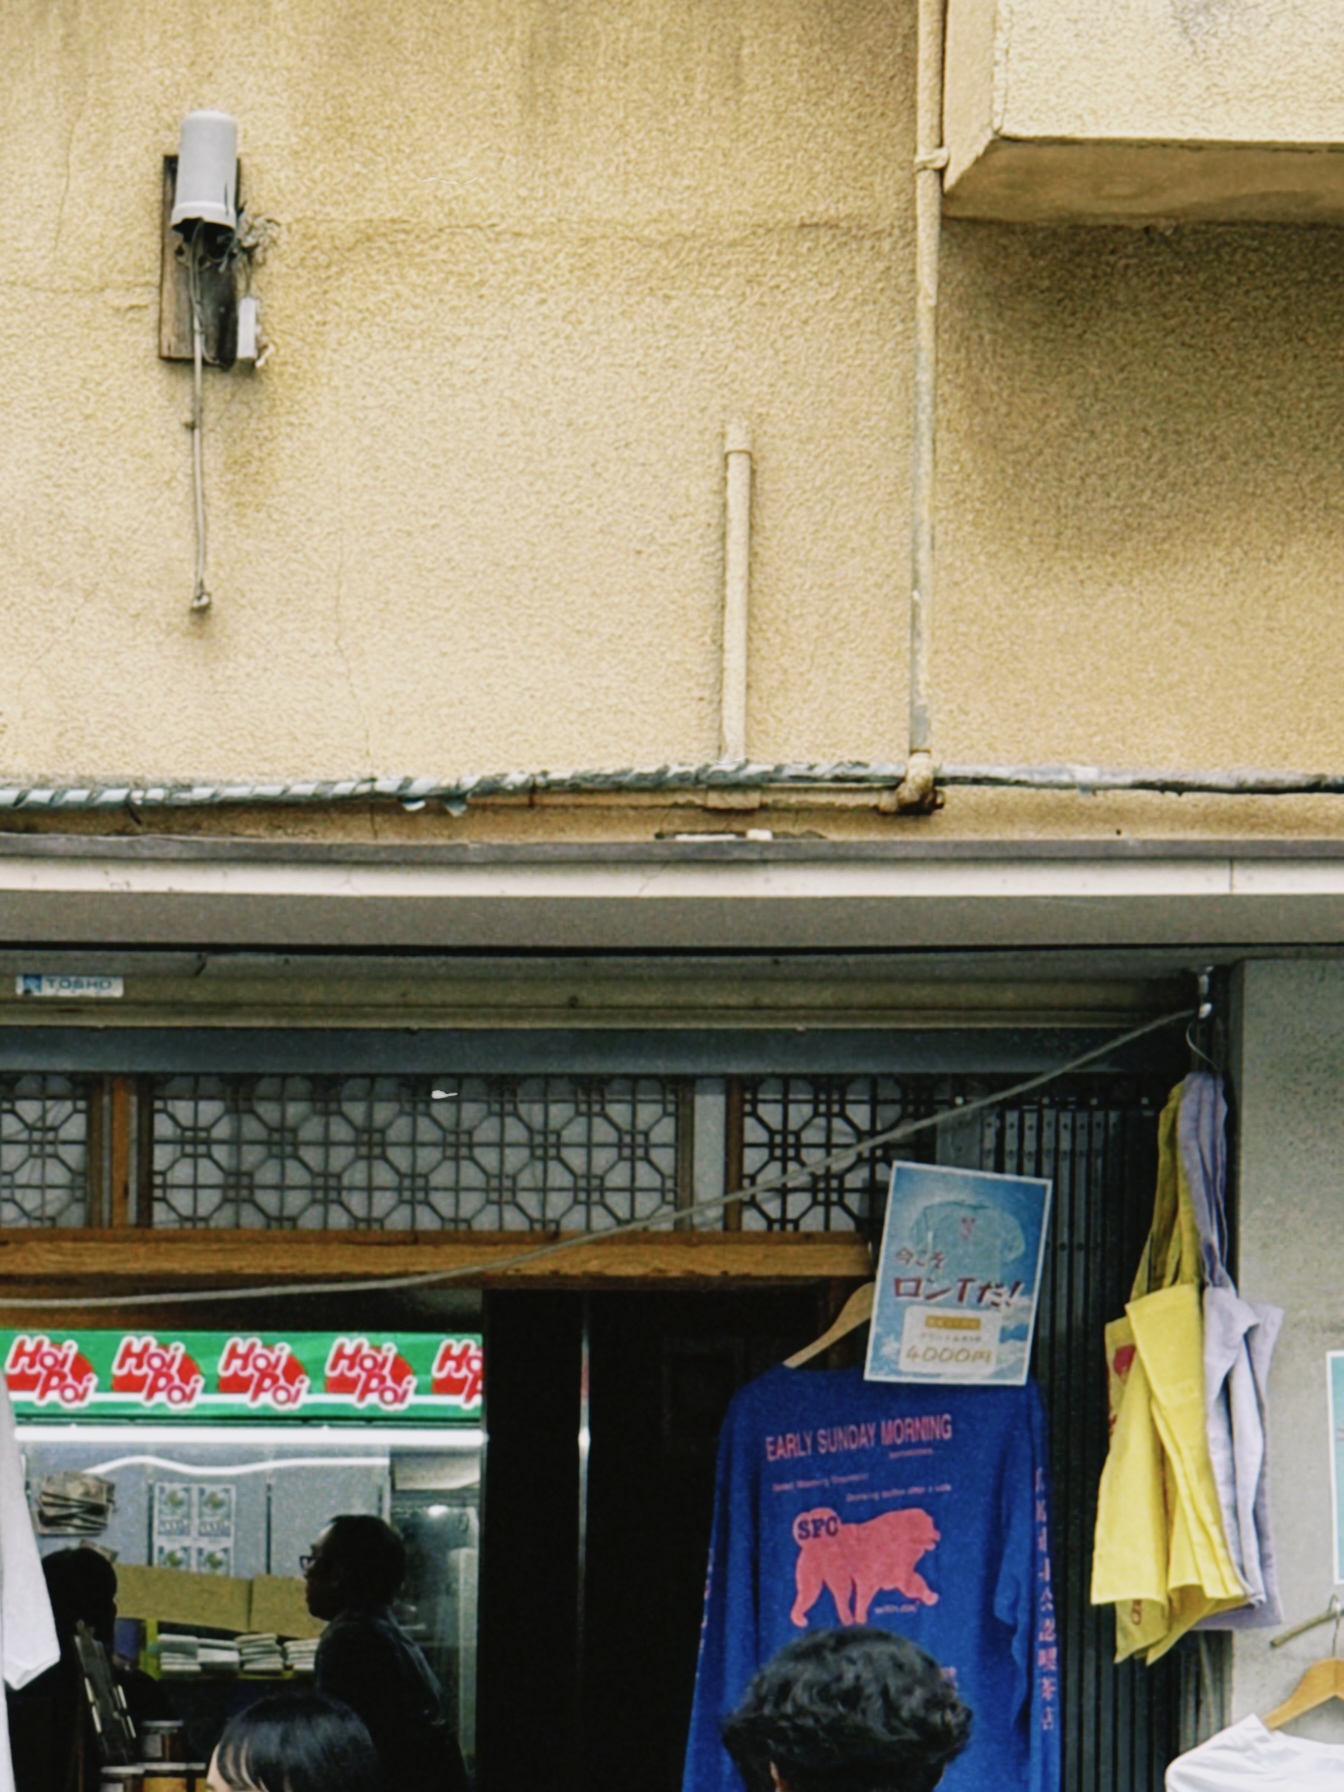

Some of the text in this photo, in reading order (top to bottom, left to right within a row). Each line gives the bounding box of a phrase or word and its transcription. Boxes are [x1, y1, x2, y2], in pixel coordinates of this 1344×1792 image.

[895, 1247, 946, 1270] 今こそ
[906, 1345, 992, 1365] 4000円
[765, 1413, 953, 1462] EARLY SUNDAY MORNING
